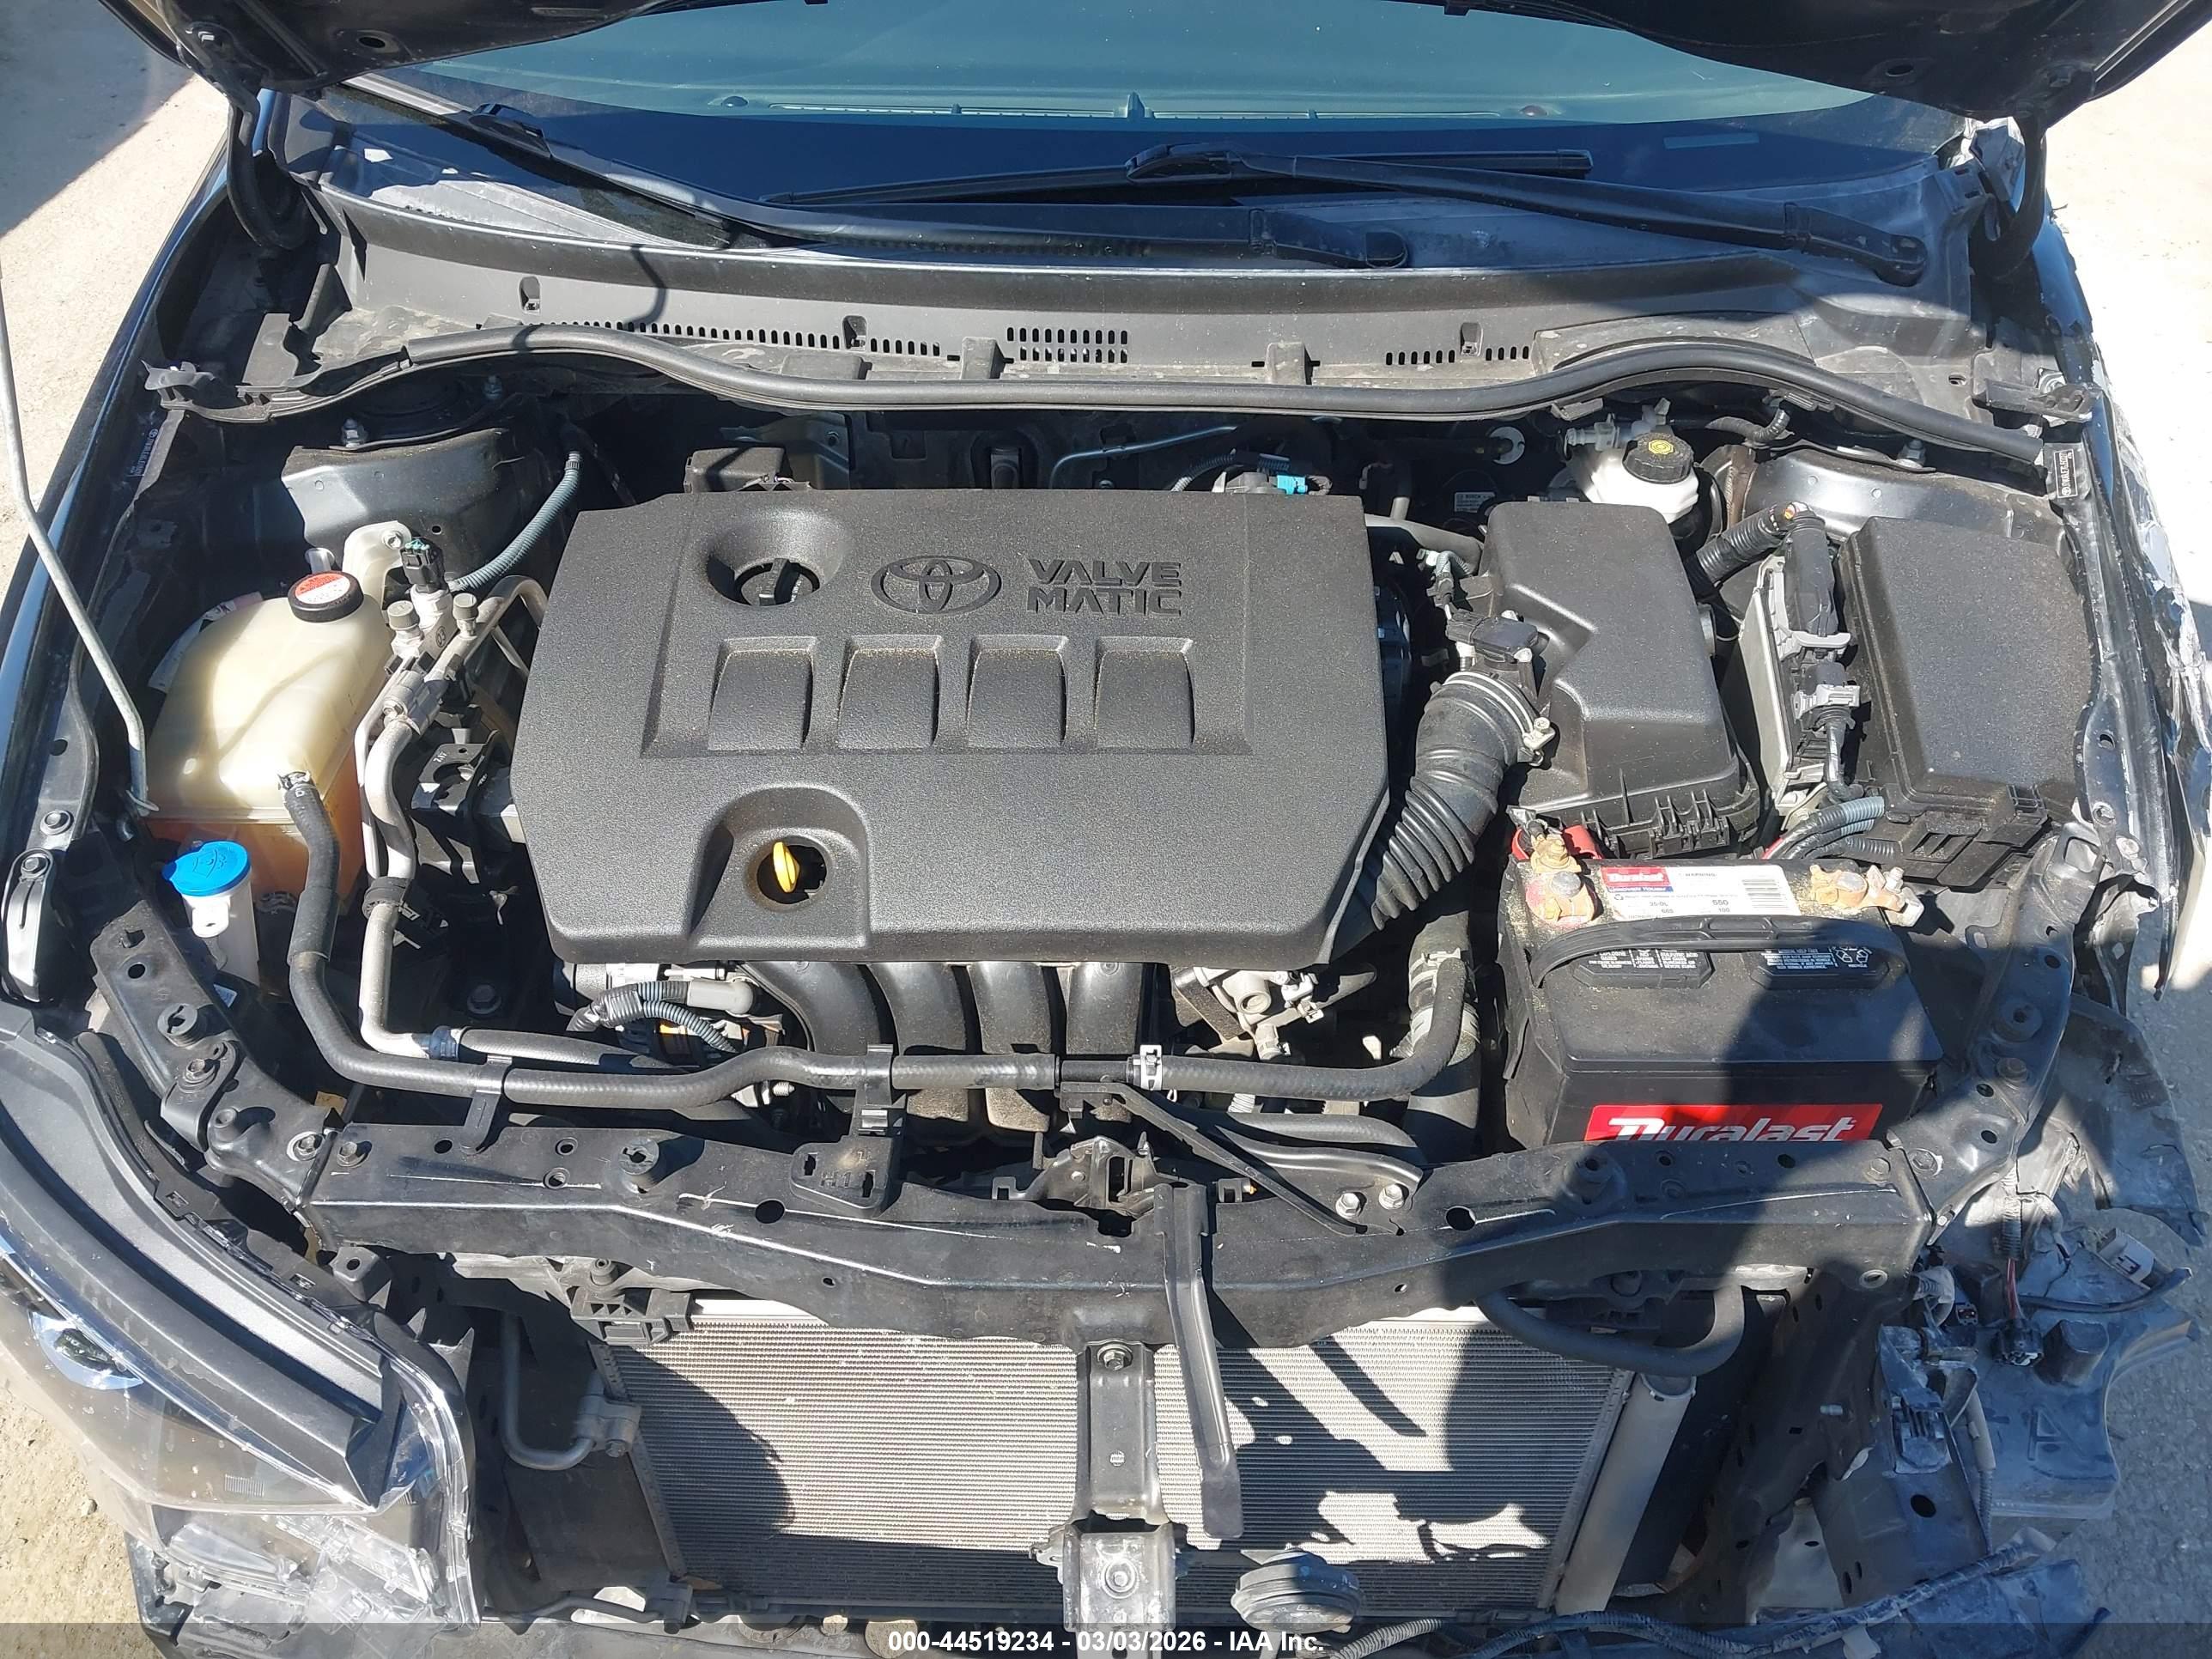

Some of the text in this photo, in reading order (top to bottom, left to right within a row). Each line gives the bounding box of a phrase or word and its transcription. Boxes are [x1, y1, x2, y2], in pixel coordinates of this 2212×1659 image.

[1029, 559, 1182, 586] VALVE
[1027, 586, 1182, 617] MATIC
[1607, 872, 1664, 883] Duralast
